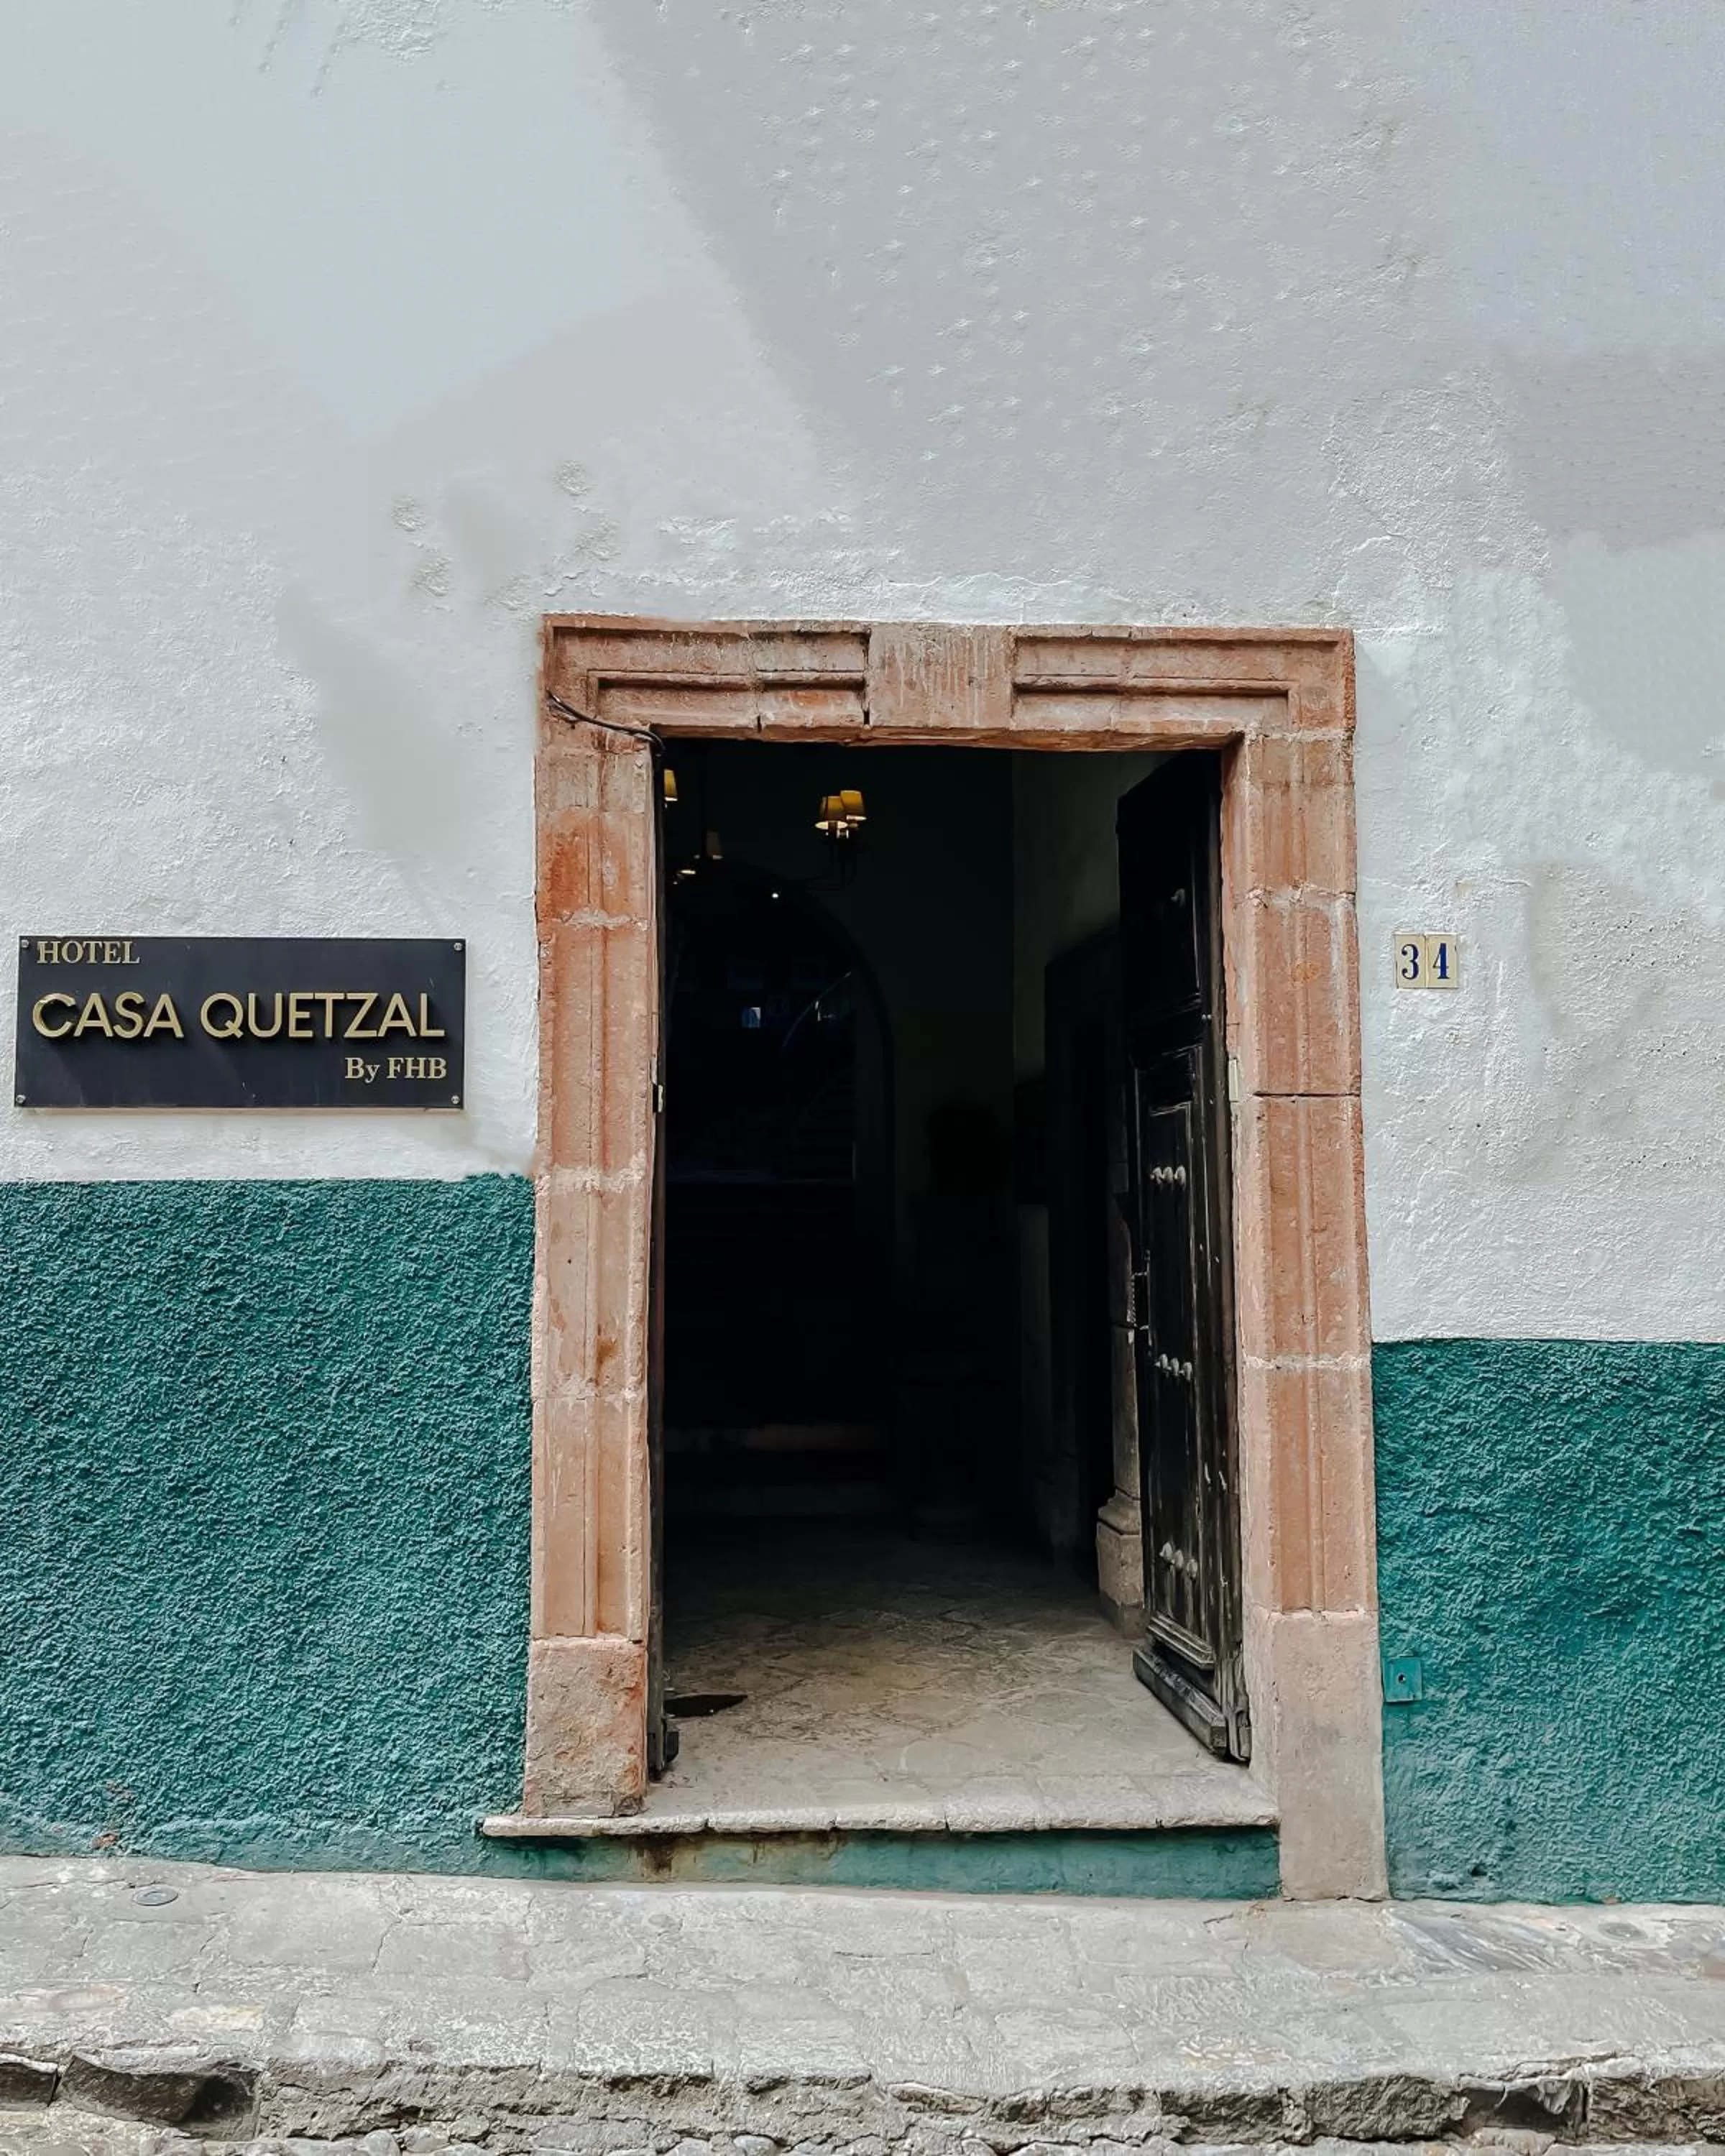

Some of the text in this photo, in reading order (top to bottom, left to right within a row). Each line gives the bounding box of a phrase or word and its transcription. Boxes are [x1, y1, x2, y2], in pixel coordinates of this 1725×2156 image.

[37, 940, 141, 964] HOTEL
[1401, 942, 1450, 980] 34
[32, 992, 446, 1039] CASA QUETZAL
[344, 1056, 447, 1084] By FHB
